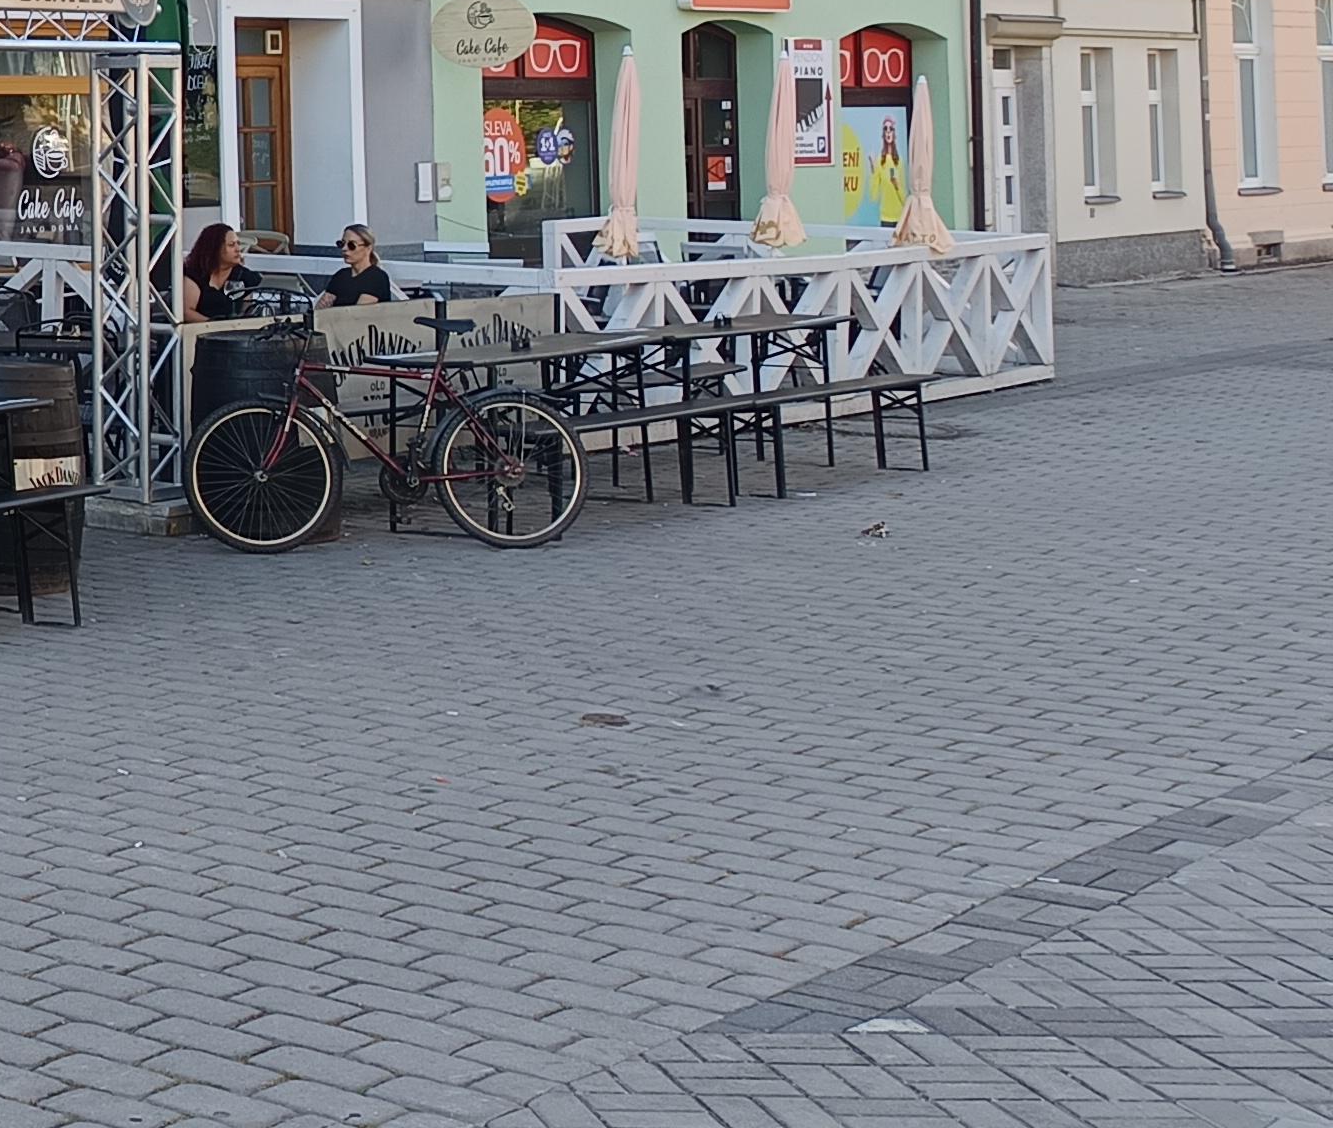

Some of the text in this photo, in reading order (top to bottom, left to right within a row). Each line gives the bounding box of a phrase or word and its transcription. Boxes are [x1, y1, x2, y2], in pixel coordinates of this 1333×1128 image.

[456, 36, 508, 56] Cake Cafe
[794, 66, 823, 76] PIANO
[484, 120, 514, 136] SLEVA
[484, 137, 521, 176] 60%
[18, 187, 84, 223] Cake Cafe
[20, 224, 80, 234] JAKO DOMA
[370, 380, 386, 392] OLD
